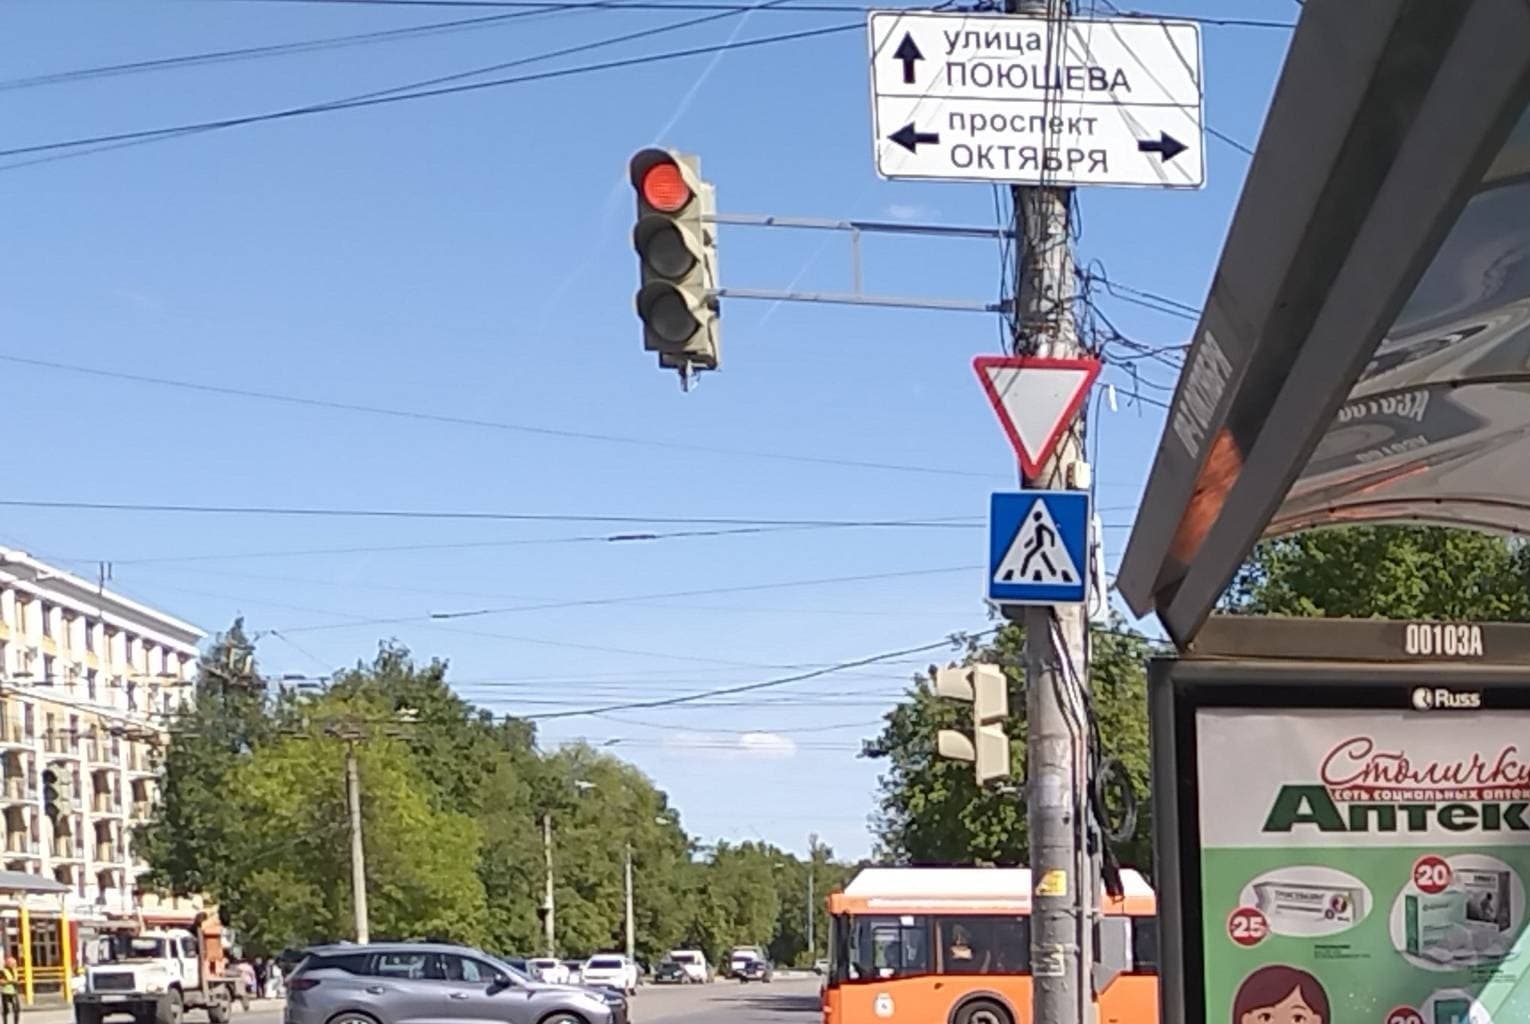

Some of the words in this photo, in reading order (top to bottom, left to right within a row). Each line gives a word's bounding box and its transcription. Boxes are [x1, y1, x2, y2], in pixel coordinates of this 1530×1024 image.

[944, 29, 1042, 56] улица
[948, 111, 1099, 138] проспект
[950, 143, 1109, 174] ОКТЯБРЯ
[1434, 688, 1481, 709] Russ
